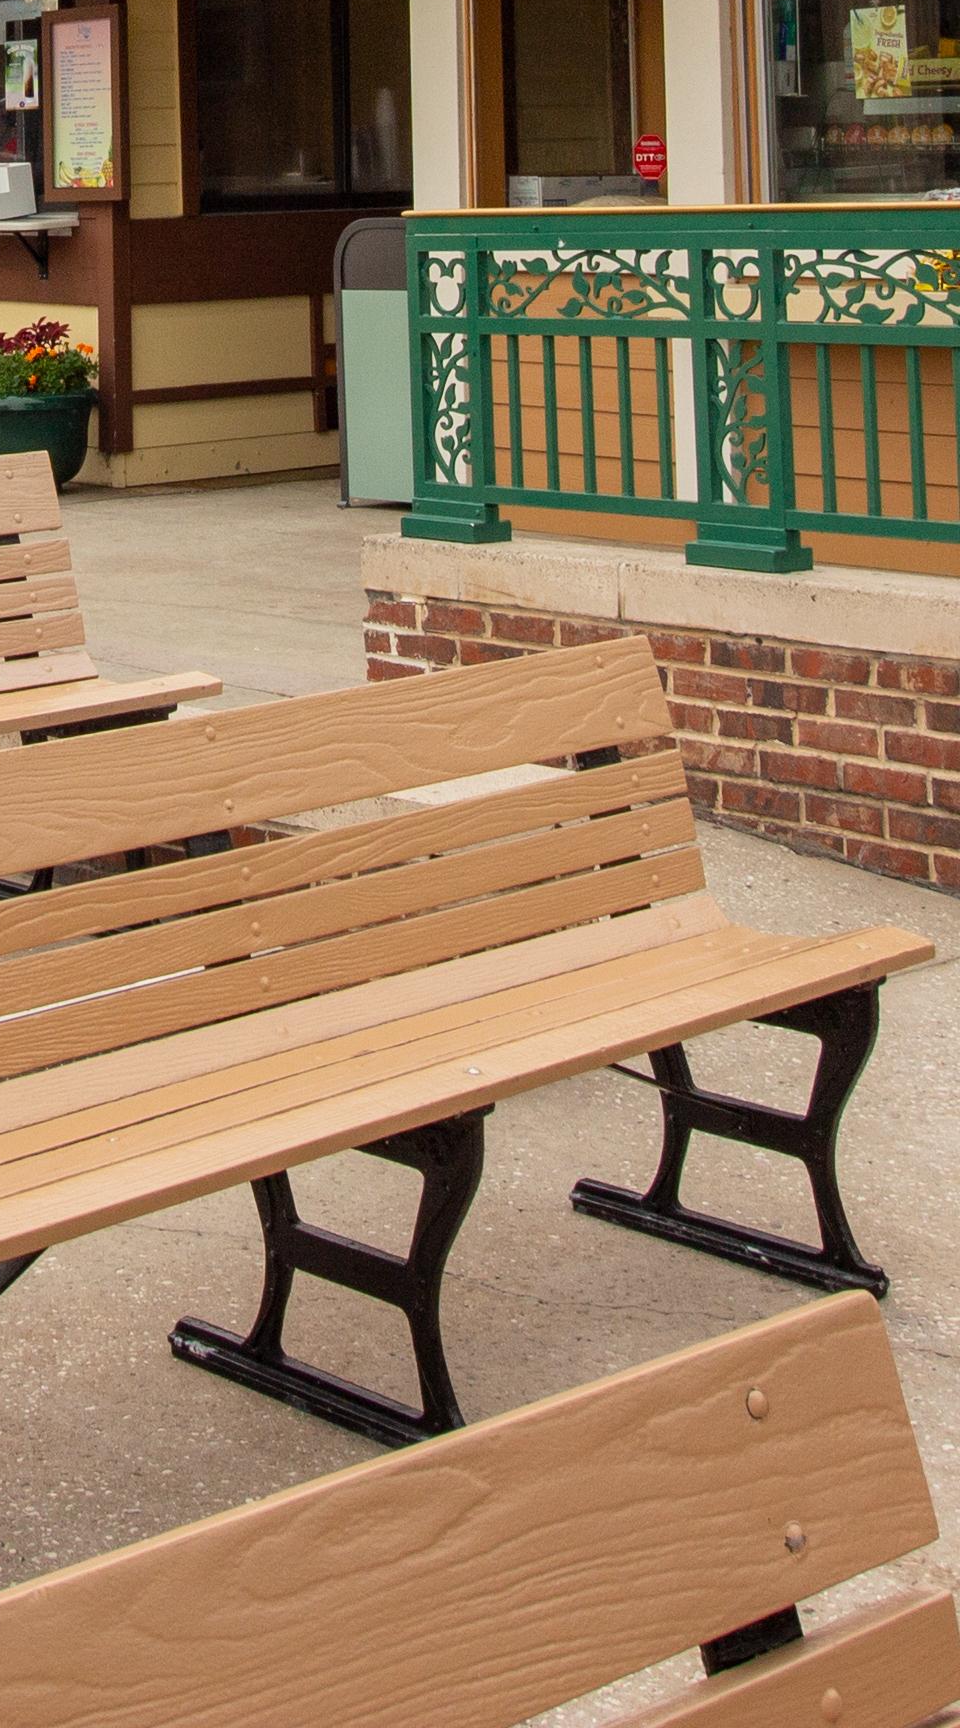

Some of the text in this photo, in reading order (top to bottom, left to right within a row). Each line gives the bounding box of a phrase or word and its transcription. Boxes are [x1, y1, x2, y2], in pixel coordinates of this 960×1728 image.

[877, 38, 901, 49] FRESH
[918, 64, 952, 78] Cheesy
[636, 153, 654, 162] DTT
